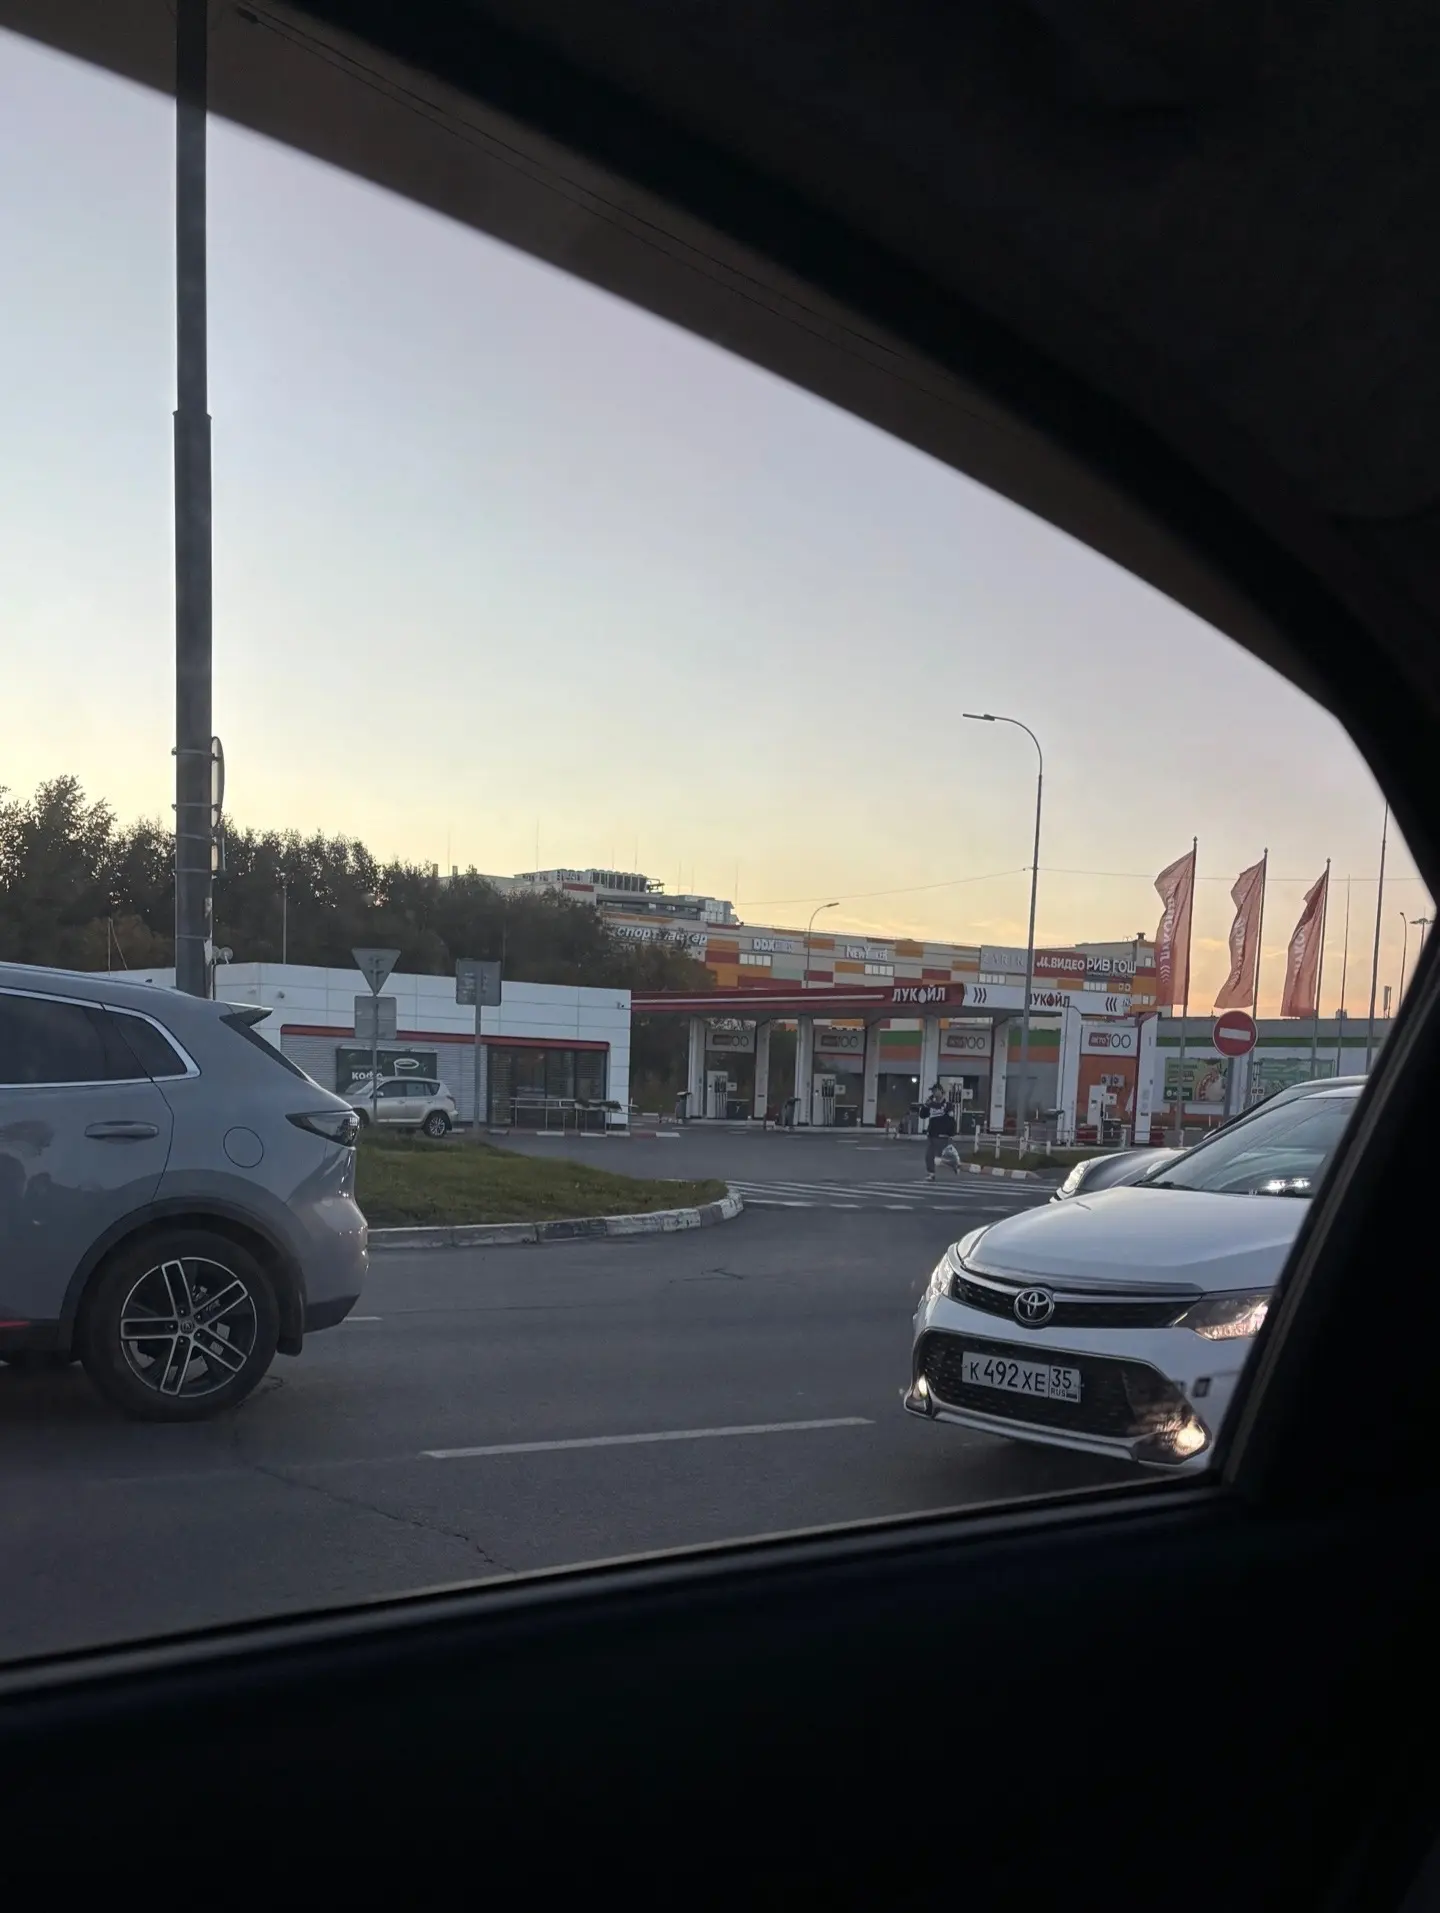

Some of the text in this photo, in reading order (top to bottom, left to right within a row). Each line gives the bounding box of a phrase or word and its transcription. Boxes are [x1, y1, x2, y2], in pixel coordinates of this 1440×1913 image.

[1086, 957, 1137, 974] РИВ ГОШ
[892, 984, 946, 1003] ЛУКОЙЛ
[970, 1359, 1072, 1392] К492ХЕ 35
[1050, 1388, 1066, 1397] RUS
